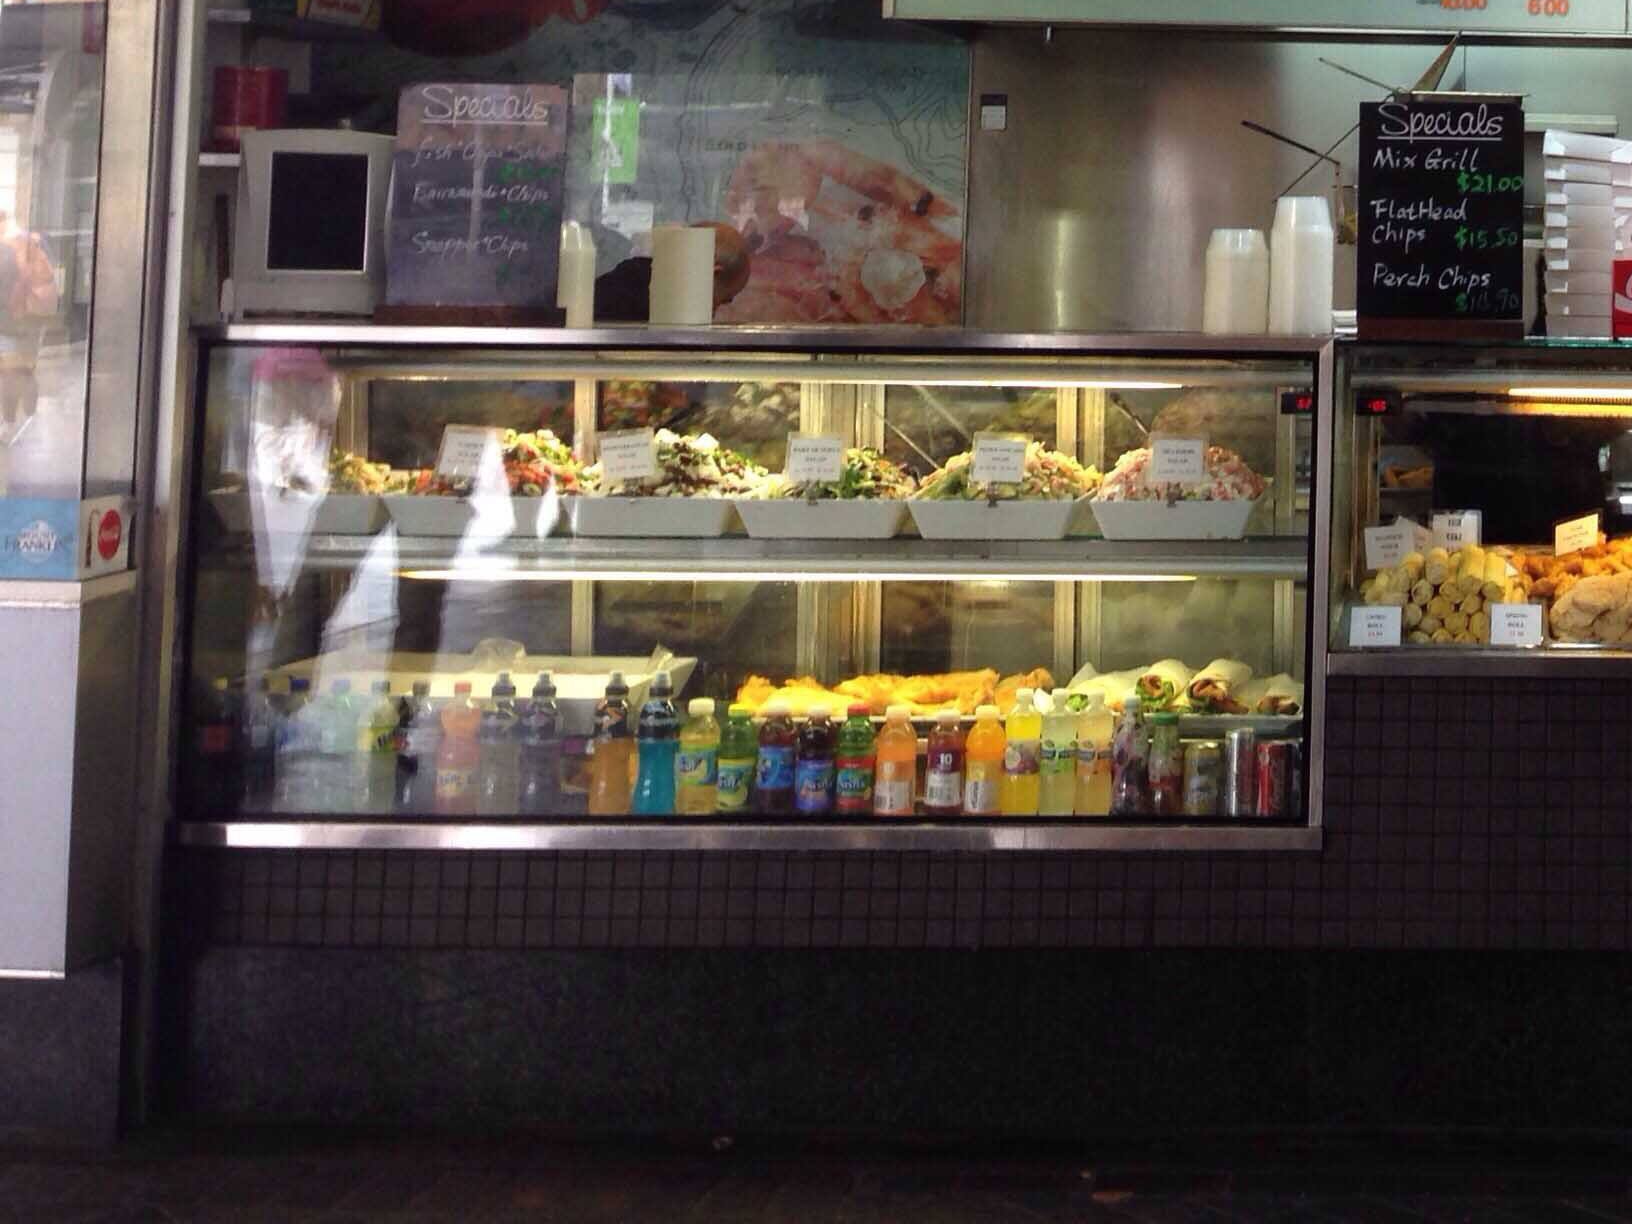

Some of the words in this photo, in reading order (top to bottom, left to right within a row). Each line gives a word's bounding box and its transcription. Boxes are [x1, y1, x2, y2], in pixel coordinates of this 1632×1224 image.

[422, 86, 548, 127] Specials
[1378, 104, 1504, 143] Specials
[1373, 147, 1416, 169] Mix
[1425, 147, 1480, 171] Grill
[1372, 221, 1426, 254] Chips
[1372, 263, 1430, 288] Perch
[1438, 264, 1492, 294] Chips
